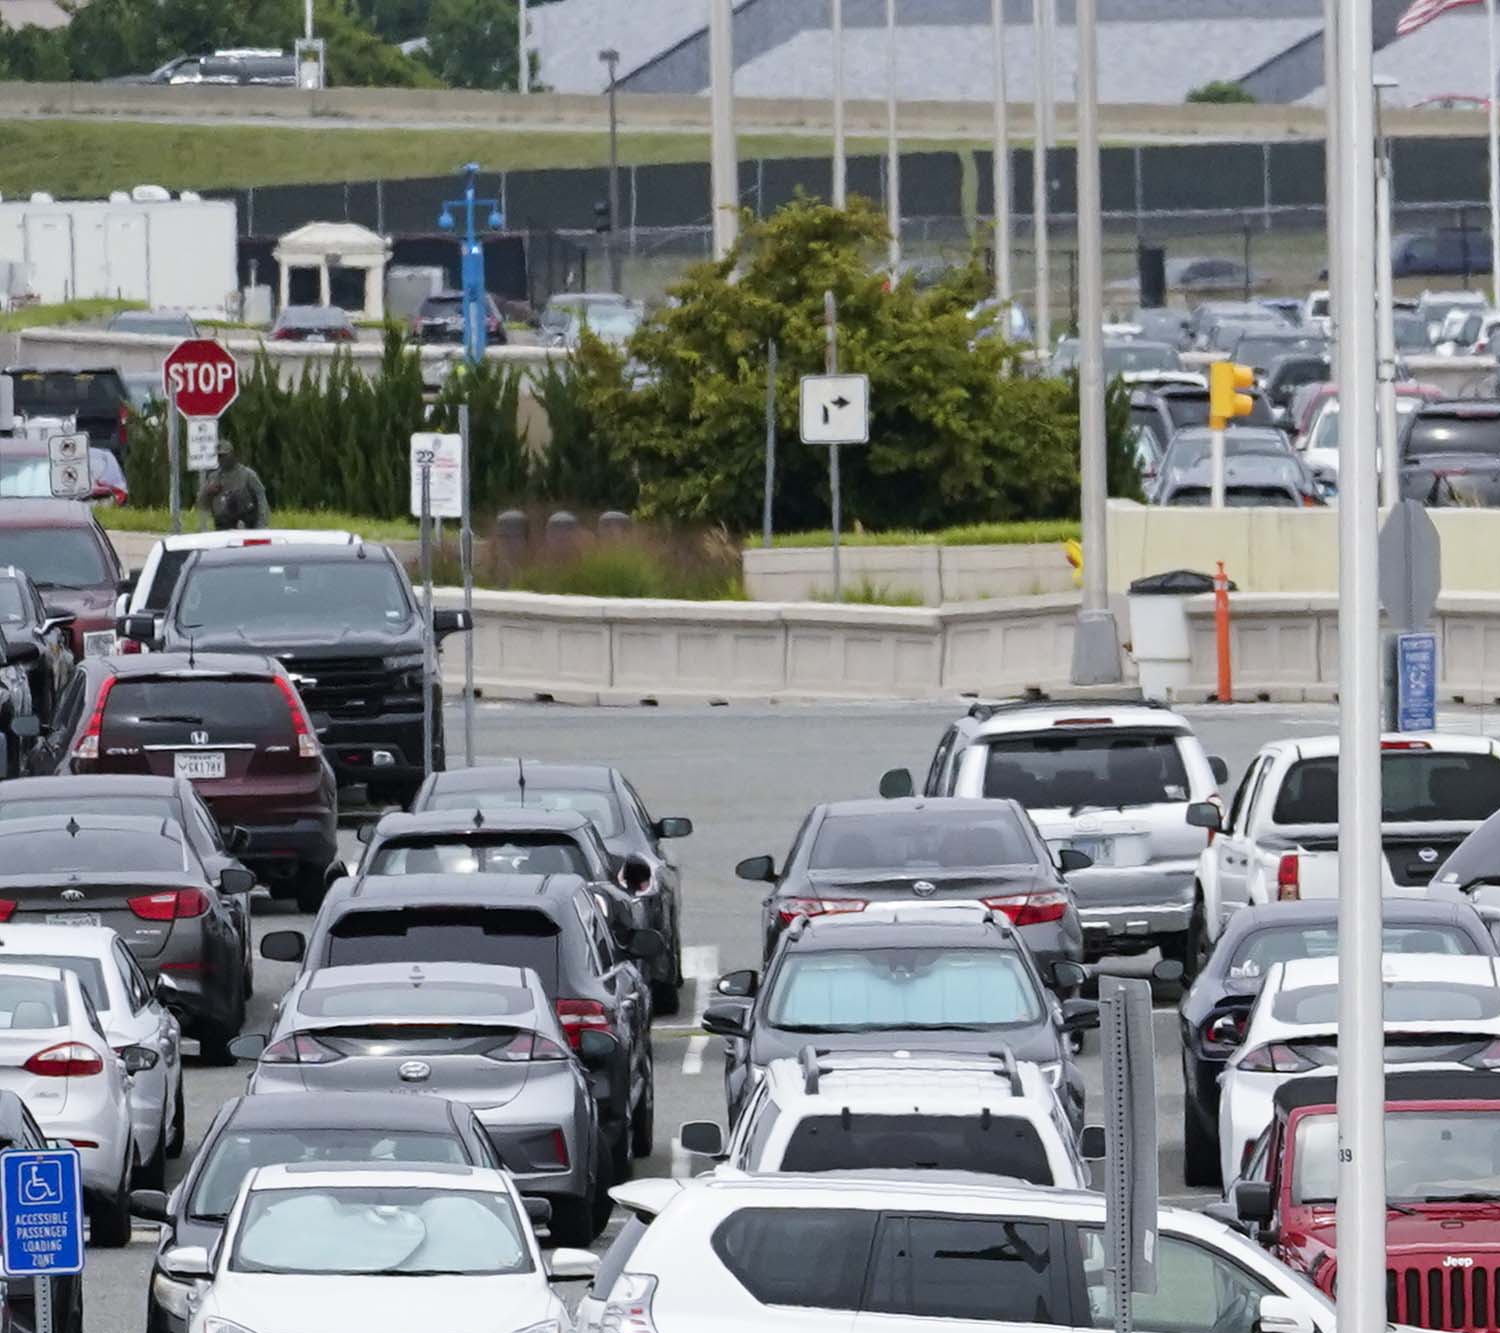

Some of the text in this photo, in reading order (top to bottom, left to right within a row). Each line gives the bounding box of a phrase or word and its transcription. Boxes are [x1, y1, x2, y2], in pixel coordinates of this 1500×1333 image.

[169, 362, 233, 394] STOP
[416, 449, 435, 463] 22
[15, 1212, 69, 1226] ACCESSIBLE
[16, 1226, 68, 1240] PASSENGER
[22, 1239, 63, 1253] LOADING
[1443, 1255, 1474, 1268] Jeep
